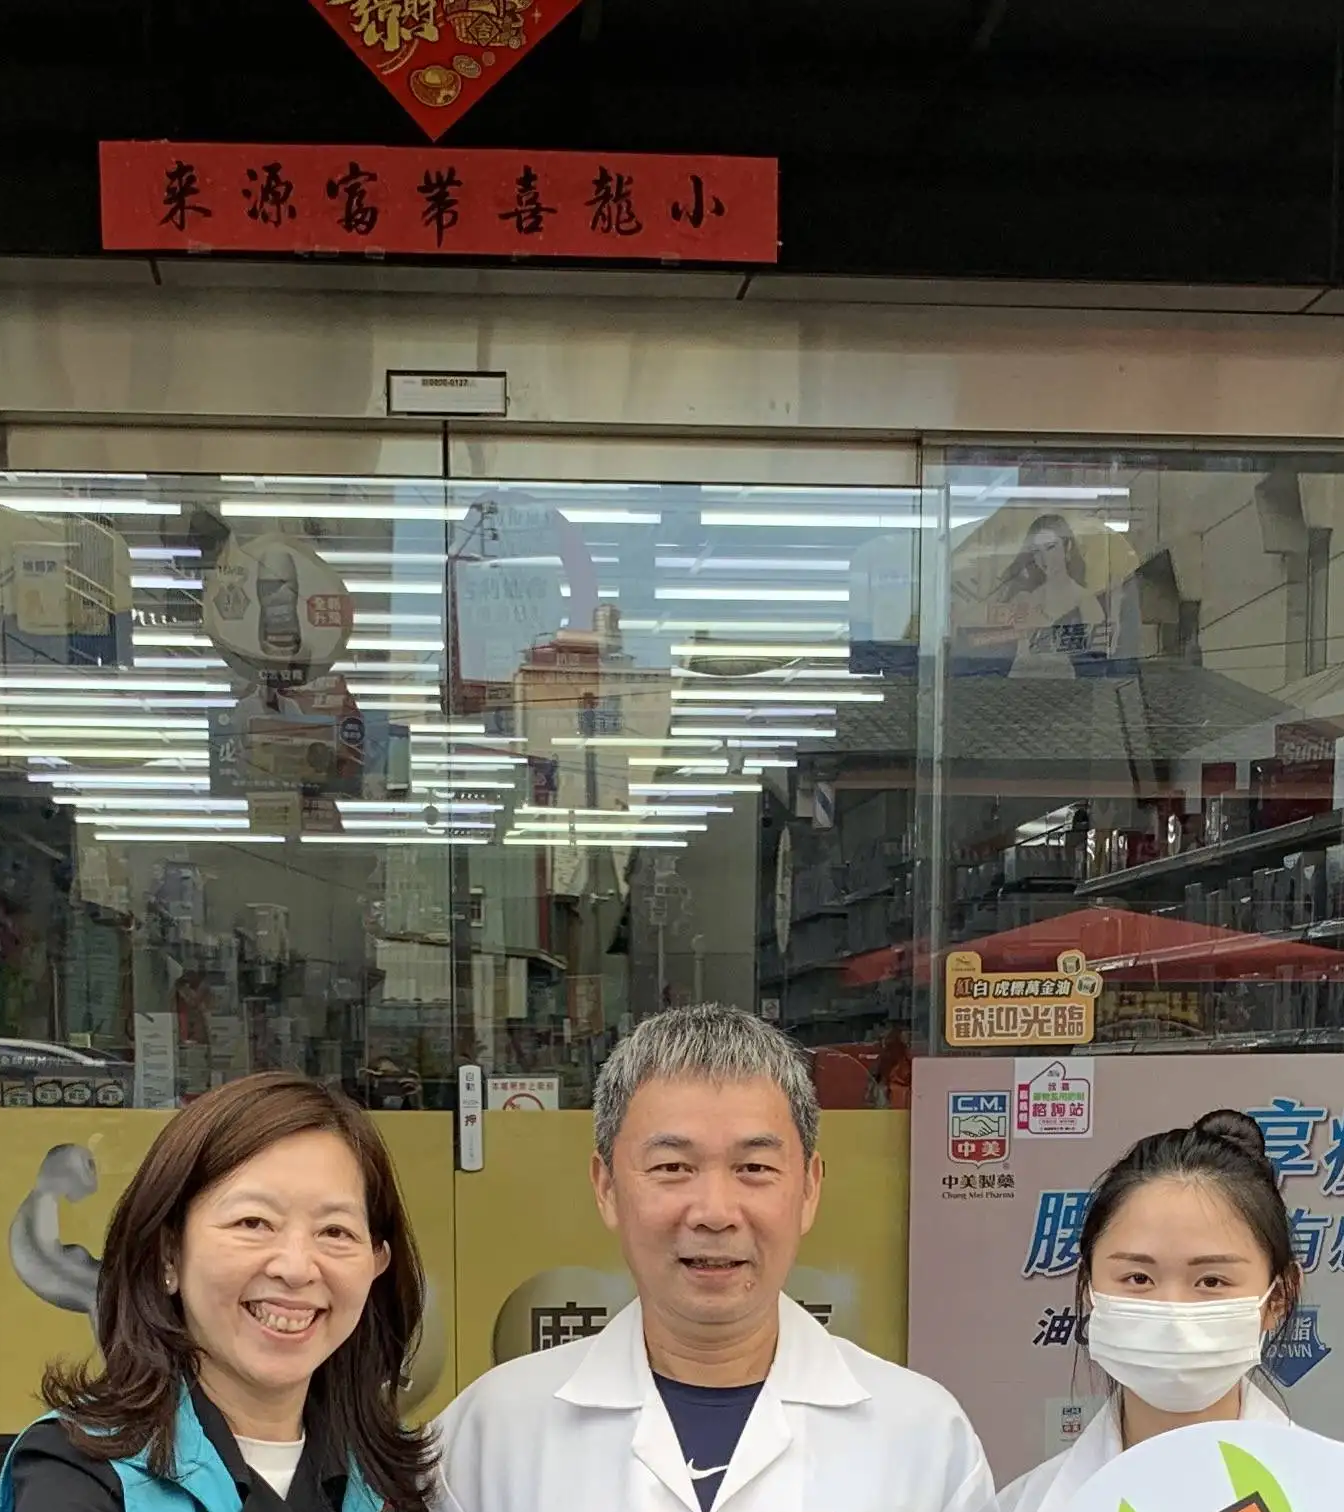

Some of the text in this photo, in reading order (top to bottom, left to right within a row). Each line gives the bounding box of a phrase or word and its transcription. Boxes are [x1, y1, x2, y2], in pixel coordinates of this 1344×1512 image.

[993, 978, 1073, 998] 虎標萬金油
[954, 1005, 1085, 1038] 歡迎光臨
[957, 1096, 1003, 1111] C.M.
[957, 1140, 1001, 1157] 中美
[942, 1174, 1015, 1190] 中美製藥
